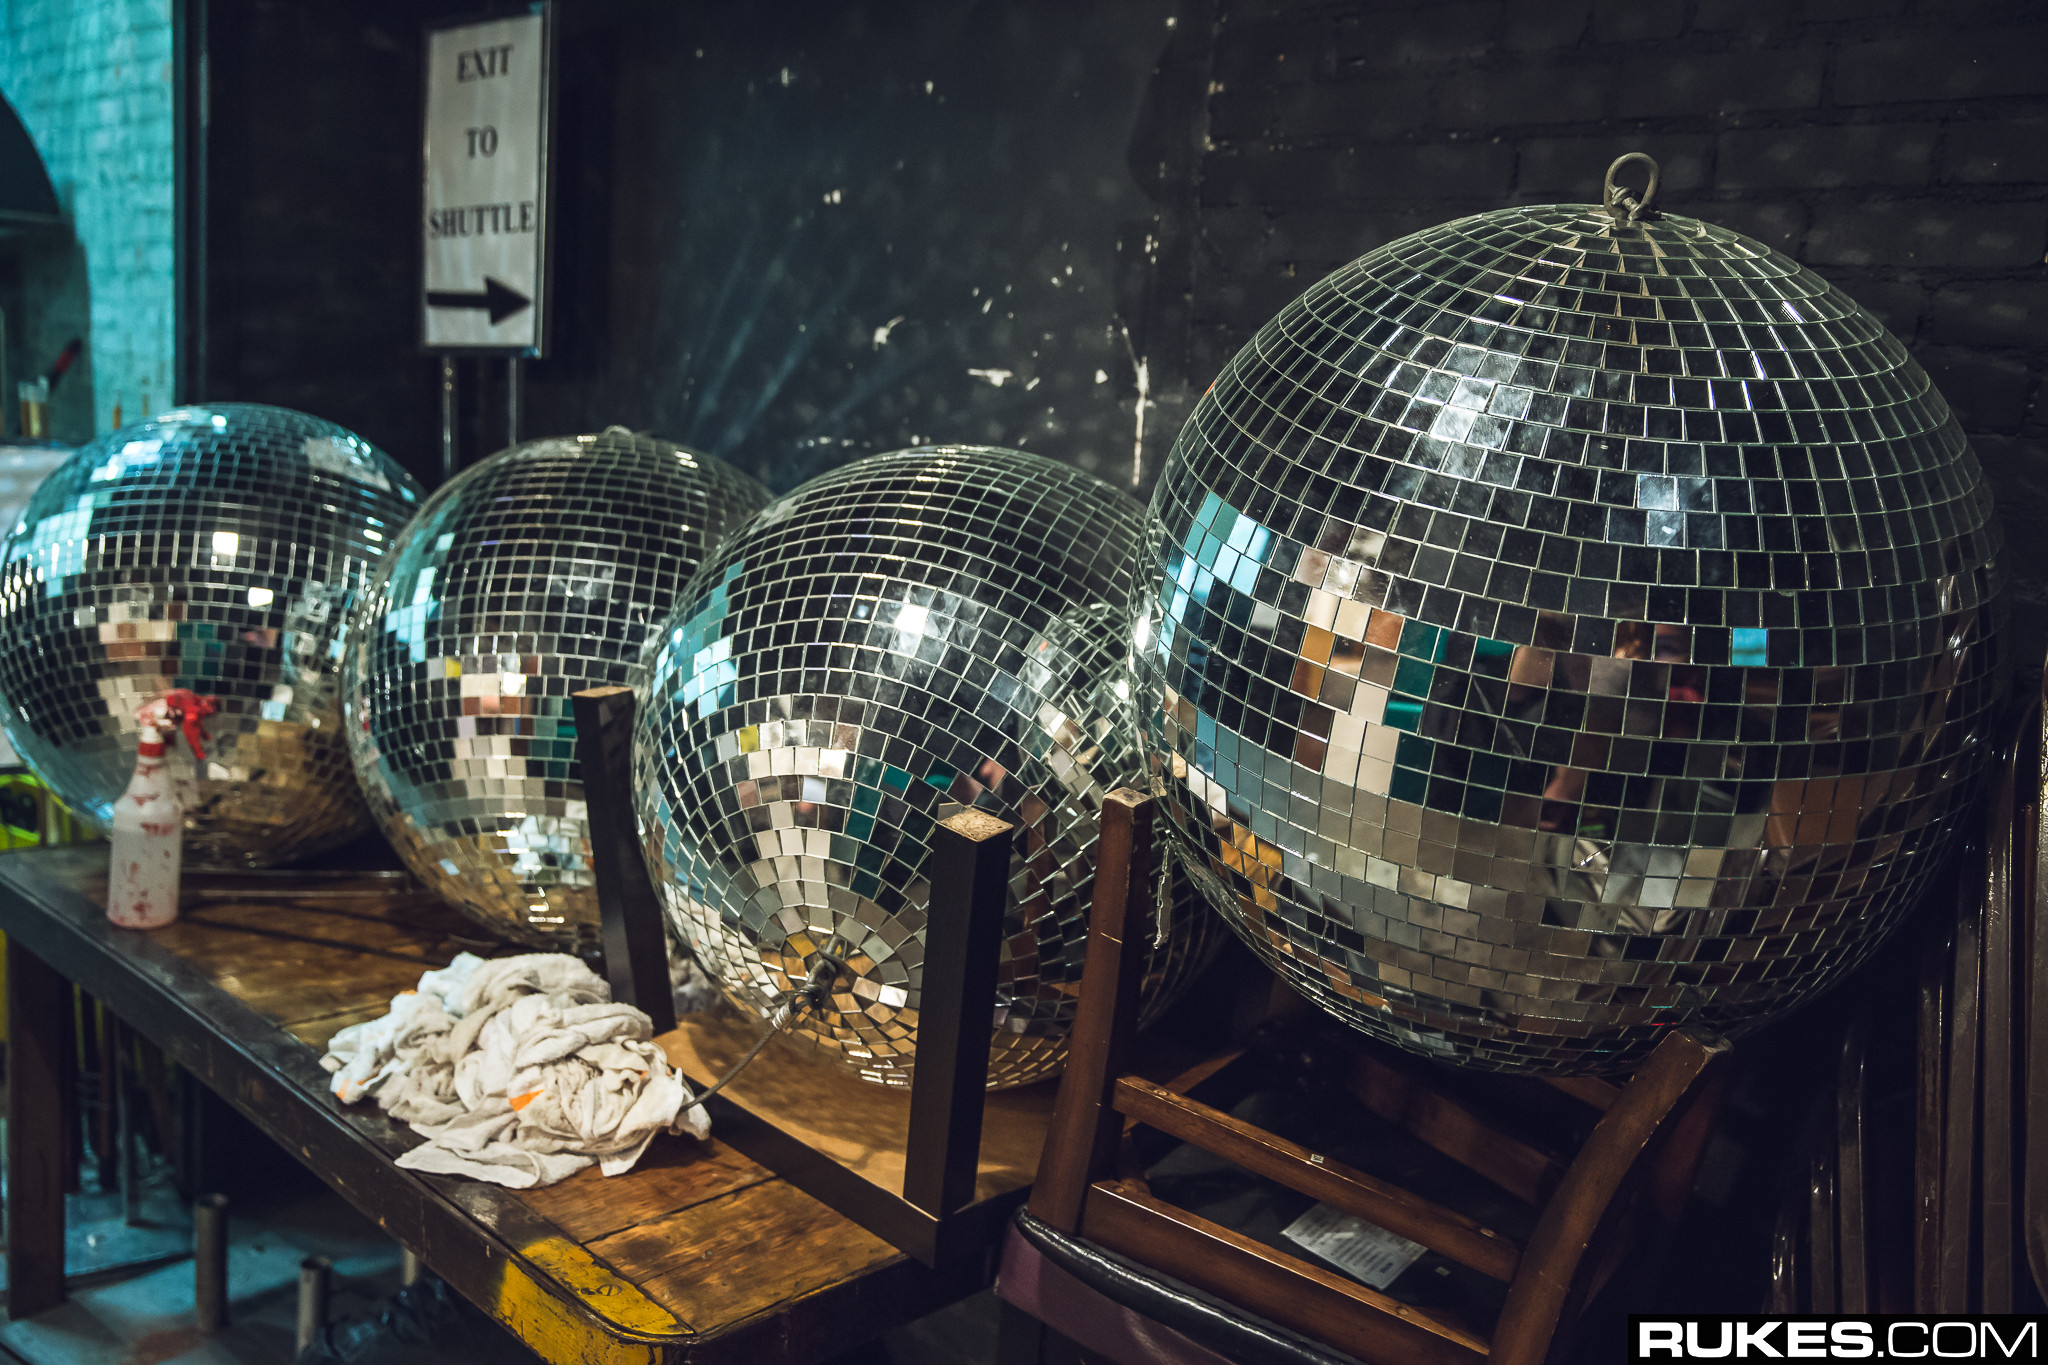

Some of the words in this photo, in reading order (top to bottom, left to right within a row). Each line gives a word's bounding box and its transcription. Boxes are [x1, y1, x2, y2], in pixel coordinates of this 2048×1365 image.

[457, 44, 513, 83] EXIT
[466, 125, 498, 159] TO
[429, 202, 536, 239] SHUTTLE
